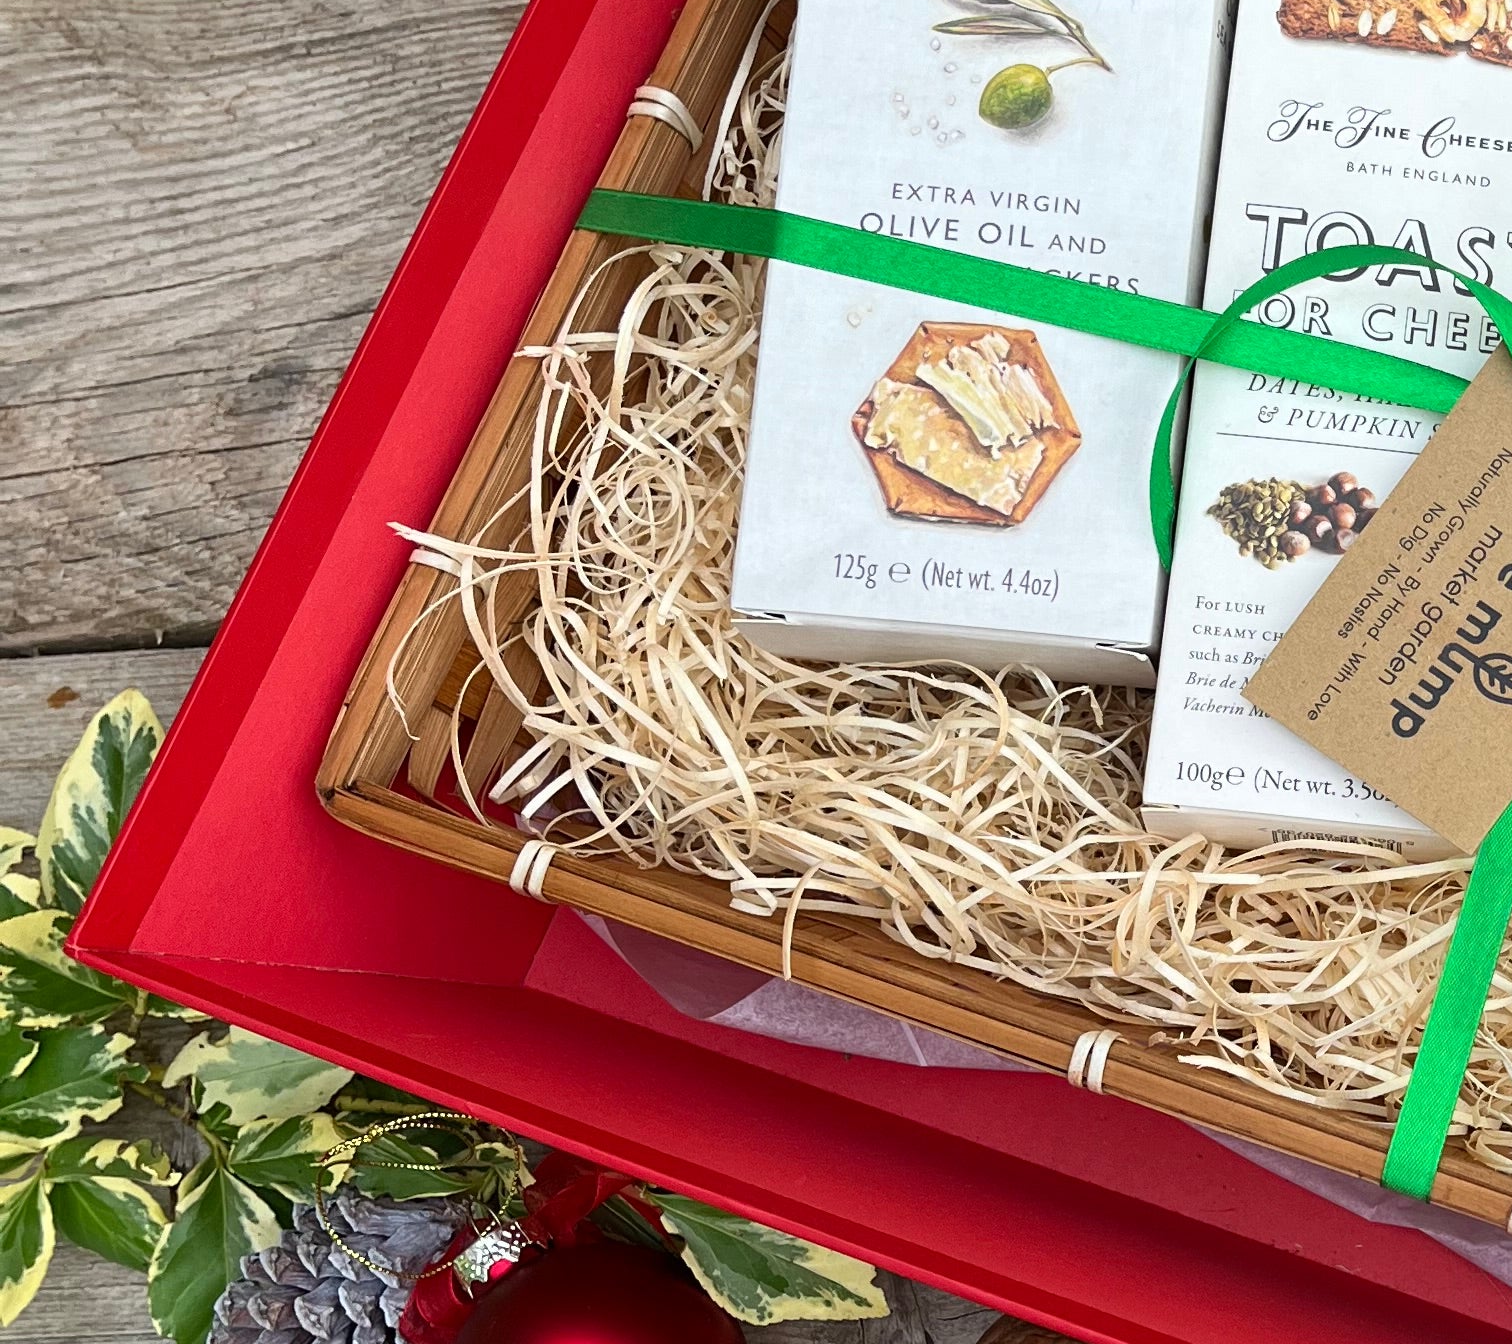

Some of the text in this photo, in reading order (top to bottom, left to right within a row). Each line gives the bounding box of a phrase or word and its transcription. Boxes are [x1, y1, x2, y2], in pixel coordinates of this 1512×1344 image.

[1345, 160, 1492, 189] BATH ENGLAND
[891, 182, 1081, 216] EXTRA VIRGIN
[859, 212, 1107, 256] OLIVE OIL AND
[1232, 288, 1504, 355] OR CHEE
[1257, 405, 1280, 424] &
[1286, 408, 1422, 440] PUMPKIN
[1422, 501, 1447, 524] No
[1399, 524, 1429, 552] Dig
[1420, 515, 1465, 564] Grown
[833, 553, 878, 589] 125g
[921, 557, 963, 591] (Net
[968, 569, 997, 593] wt.
[1001, 568, 1060, 603] 4.4oz)
[1377, 562, 1401, 586] No
[1396, 575, 1421, 598] By
[1195, 595, 1266, 616] For LUSH
[1337, 586, 1384, 639] Nasties
[1366, 597, 1406, 642] Hand
[1377, 524, 1504, 686] market garden
[1192, 624, 1258, 640] CREAMY
[1188, 647, 1221, 662] such
[1224, 653, 1240, 664] as
[1333, 652, 1367, 683] With
[1390, 600, 1503, 740] mump
[1184, 671, 1217, 688] Brie
[1219, 674, 1237, 690] de
[1182, 696, 1245, 716] Vacherin
[1307, 684, 1342, 721] Love
[1253, 766, 1301, 793] (Net
[1306, 777, 1336, 797] wt.
